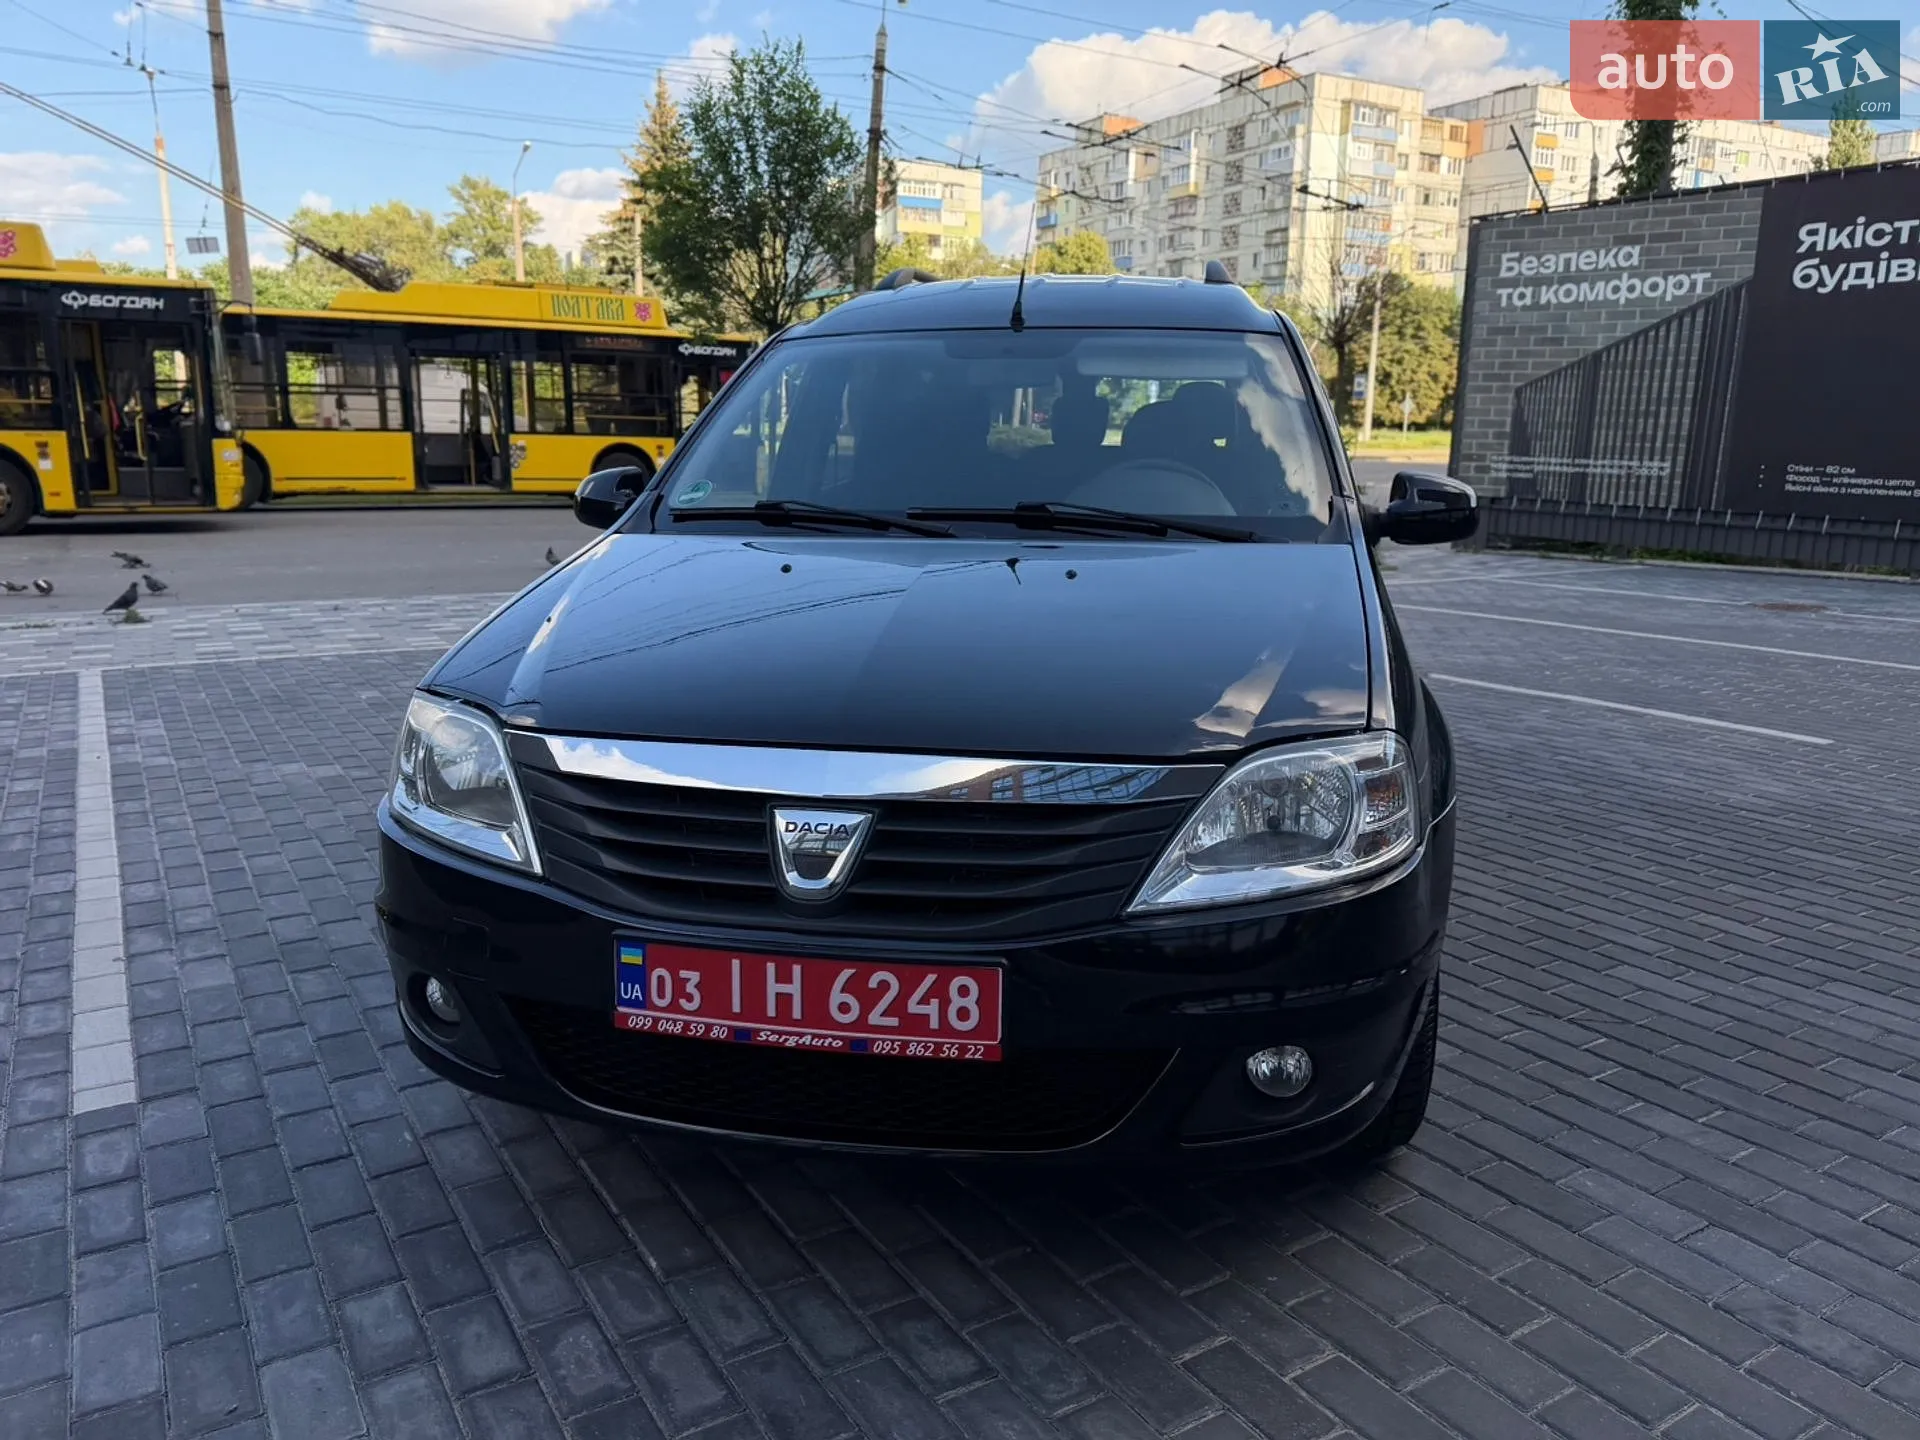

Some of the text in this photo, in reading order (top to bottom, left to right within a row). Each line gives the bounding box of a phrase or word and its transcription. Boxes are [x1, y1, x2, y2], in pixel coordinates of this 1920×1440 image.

[1796, 215, 1920, 253] Якіст
[1499, 245, 1641, 277] Безпека
[1792, 251, 1920, 294] будів
[88, 294, 164, 309] БОГДАН
[1496, 271, 1711, 308] та комфорт
[784, 821, 850, 837] DACIA
[620, 982, 643, 1001] UA
[650, 967, 702, 1012] 03
[828, 968, 980, 1032] 6248
[628, 1015, 985, 1059] 099 048 59 80 SergAuto 095 862 56 22
